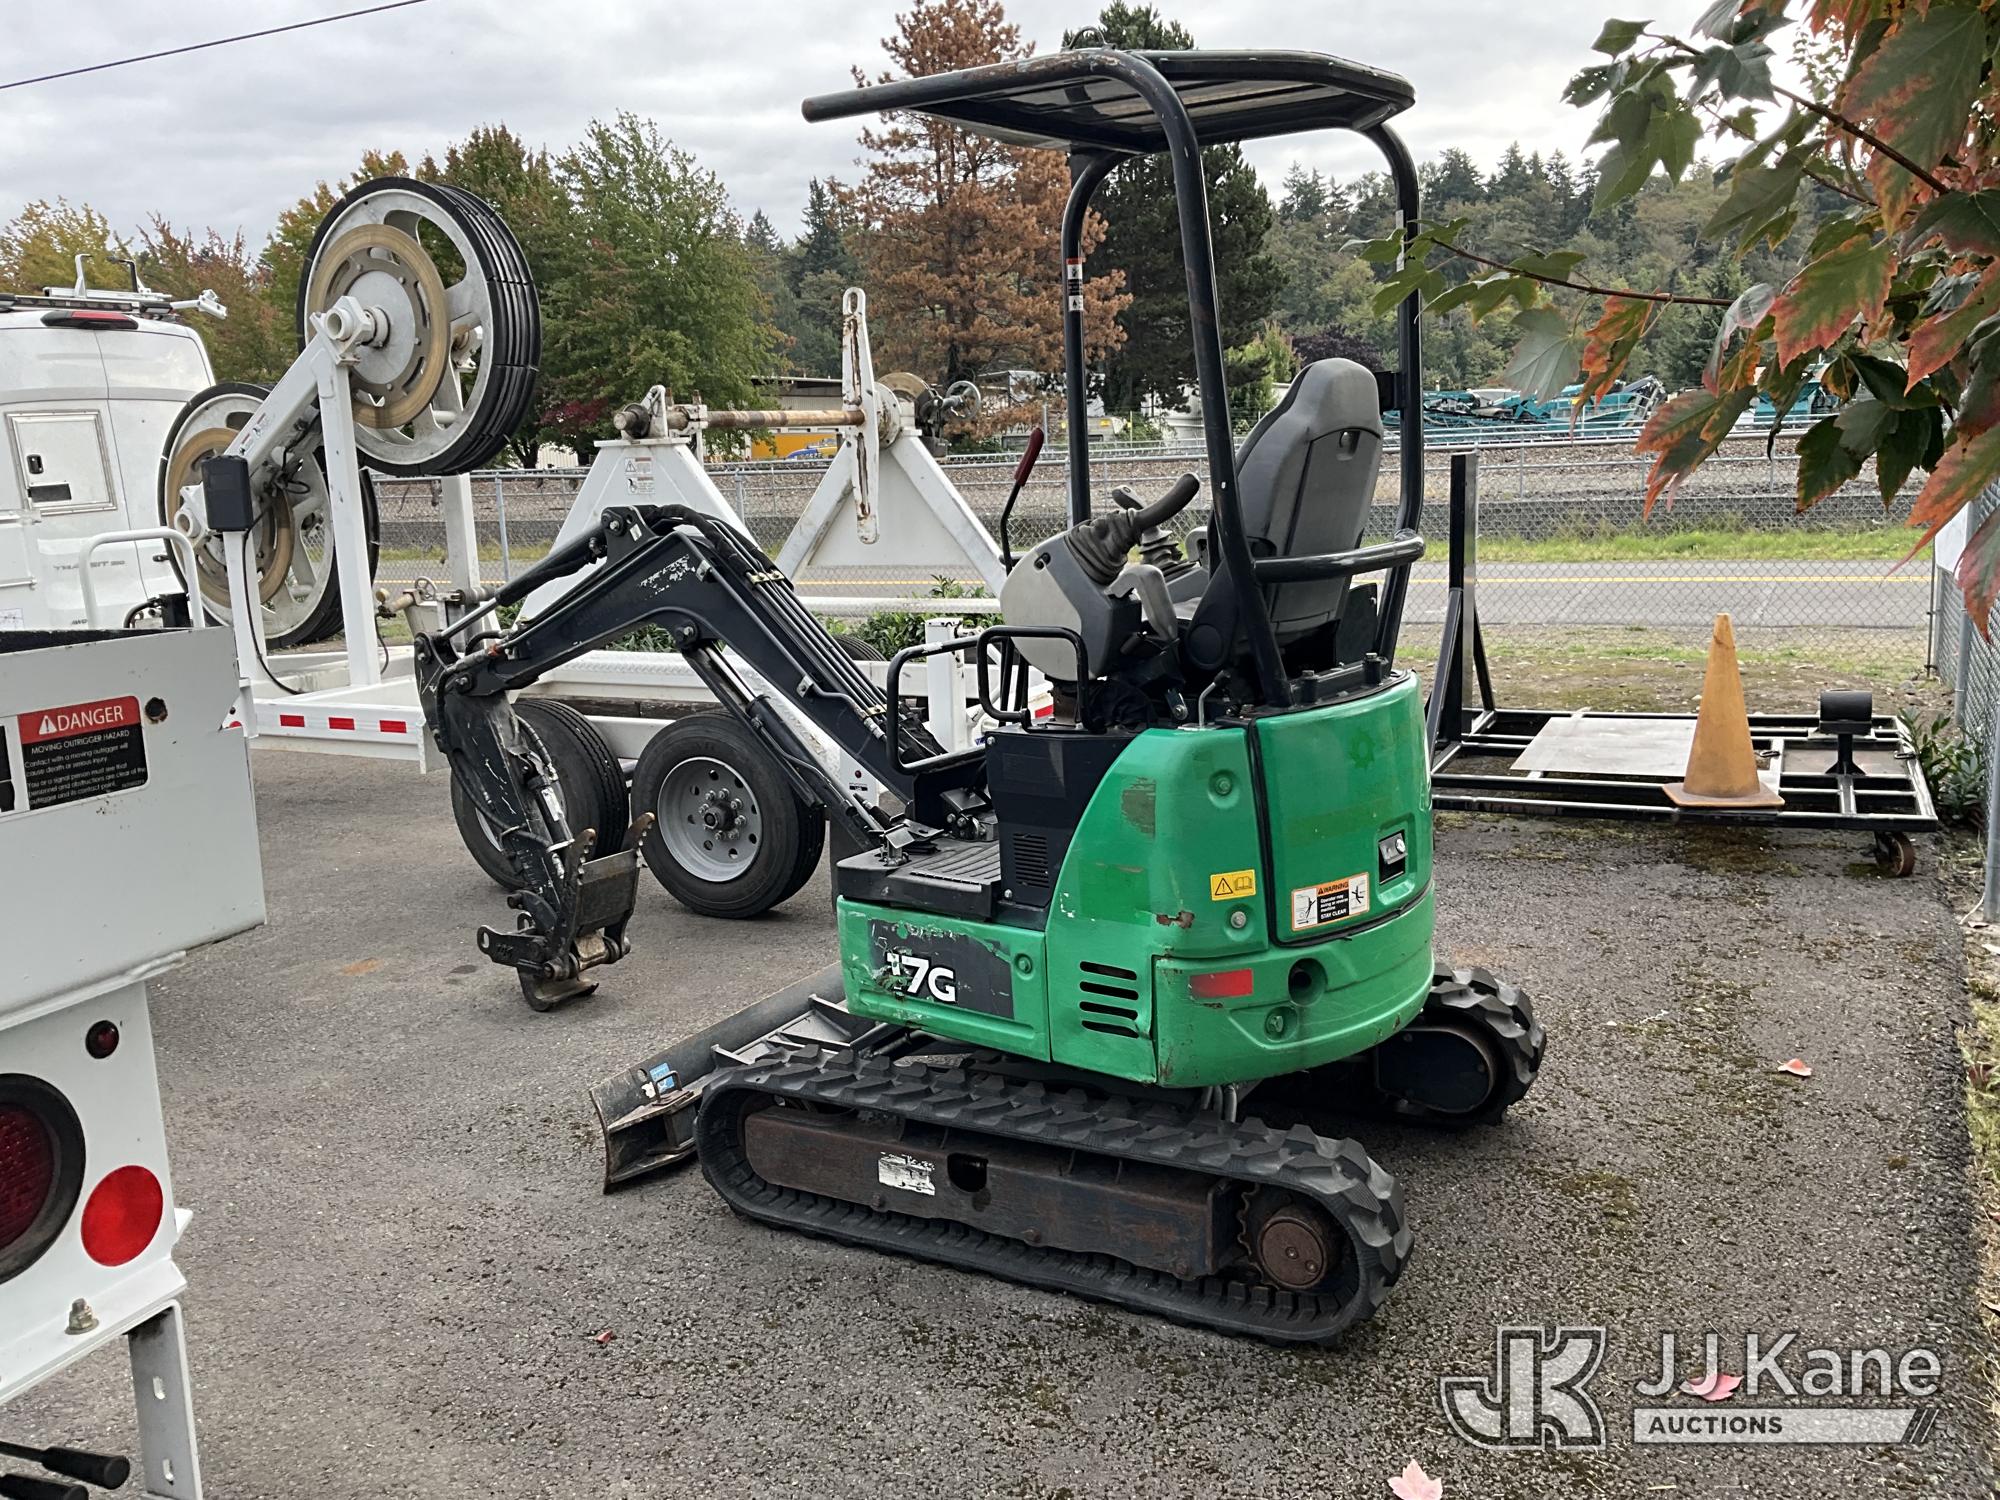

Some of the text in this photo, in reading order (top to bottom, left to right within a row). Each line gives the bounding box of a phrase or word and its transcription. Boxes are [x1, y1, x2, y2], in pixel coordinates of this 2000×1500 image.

[57, 705, 124, 732] DANGER
[31, 730, 129, 754] MOVING OUTRIGGER HAZARD
[24, 758, 50, 768] Contact
[70, 750, 92, 760] moving
[93, 745, 118, 755] outrigger
[46, 764, 64, 772] death
[71, 771, 90, 780] person
[1324, 882, 1348, 892] WARNING
[1332, 908, 1346, 916] CLEAR
[887, 952, 956, 1002] 17G
